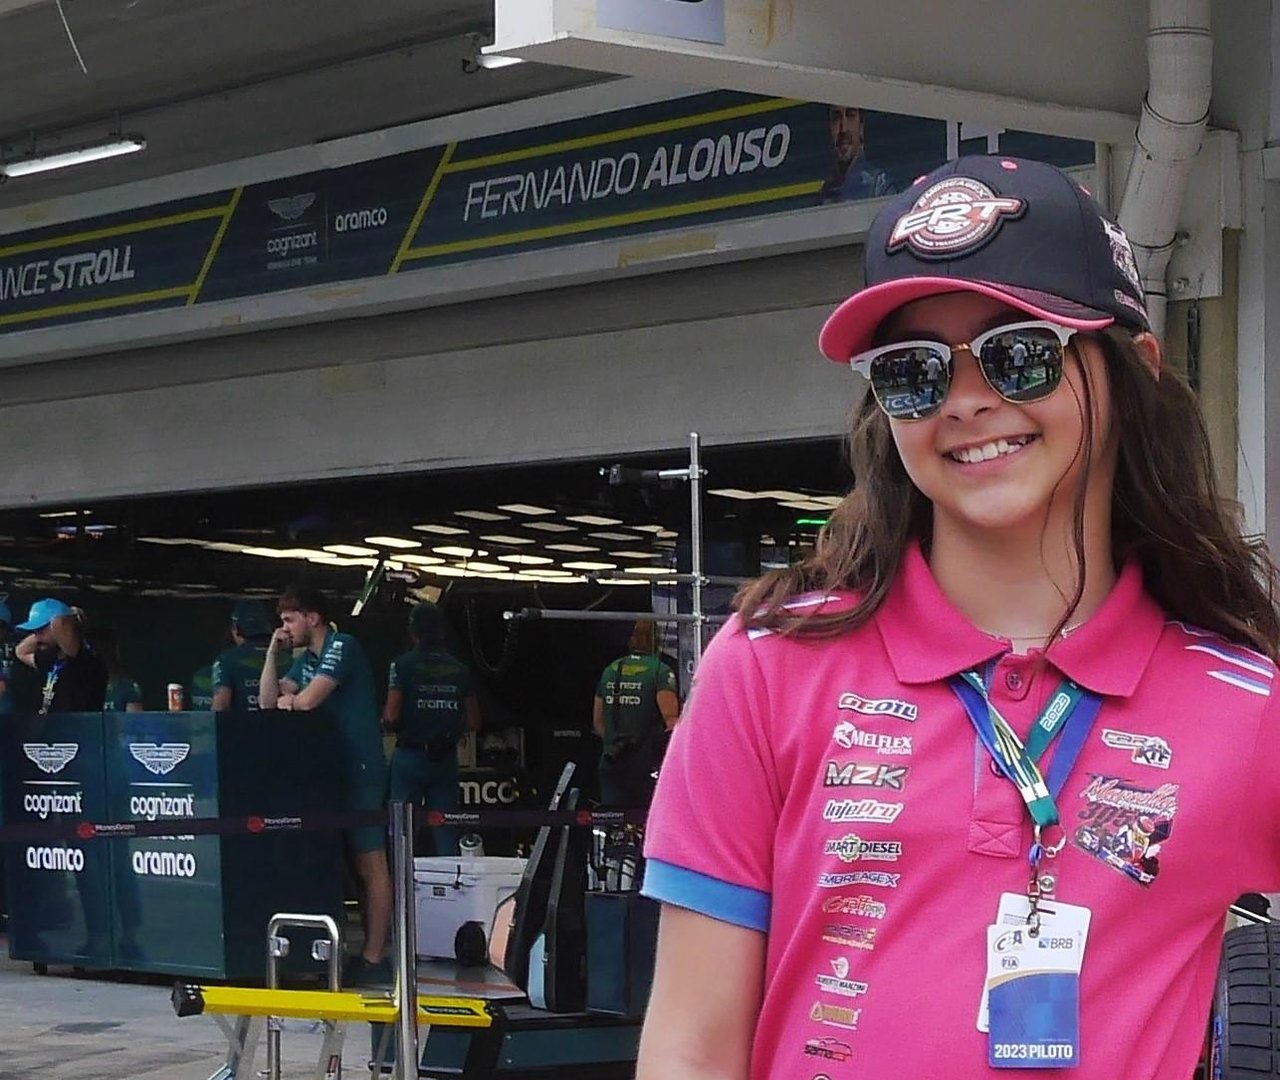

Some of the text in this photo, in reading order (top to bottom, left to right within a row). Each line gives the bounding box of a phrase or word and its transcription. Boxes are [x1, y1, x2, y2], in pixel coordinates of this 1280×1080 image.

[464, 123, 791, 222] FERNANDO ALONSO
[335, 207, 387, 232] aramco
[893, 199, 1013, 243] ERT
[266, 231, 318, 256] cognizant
[51, 245, 135, 291] STROLL
[1043, 694, 1069, 730] 2023
[850, 729, 913, 749] MELFLEX
[824, 760, 908, 790] MZK
[24, 791, 83, 819] cognizant
[130, 793, 195, 821] cognizant
[26, 846, 84, 872] aramco
[859, 842, 901, 854] DIESEL
[132, 850, 196, 877] aramco
[1050, 938, 1074, 950] BRB
[1002, 957, 1018, 969] FIA
[995, 1044, 1073, 1059] 2023 PILOTO
